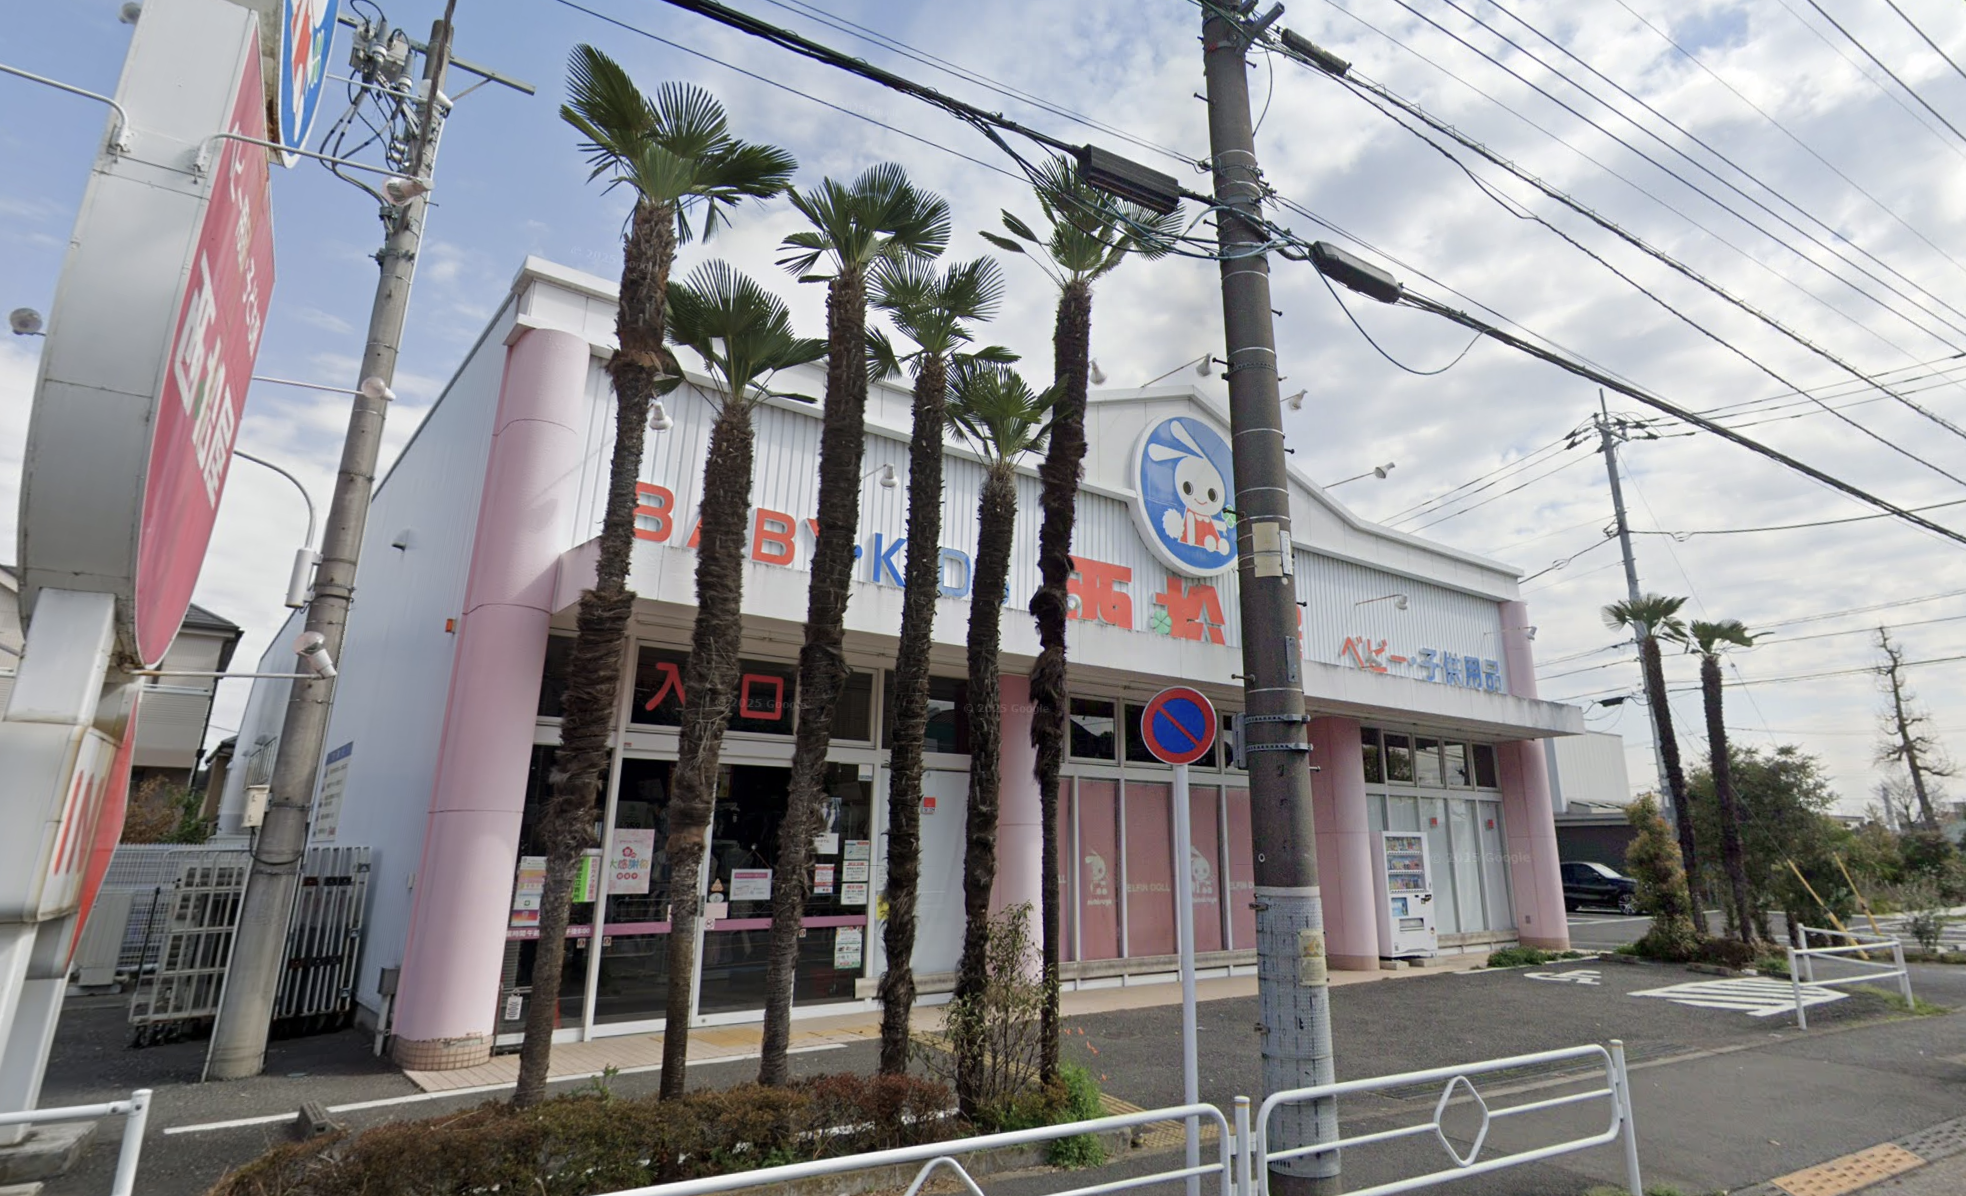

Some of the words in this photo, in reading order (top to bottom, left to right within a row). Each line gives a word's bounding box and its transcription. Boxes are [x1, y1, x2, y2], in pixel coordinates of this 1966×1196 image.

[1067, 555, 1303, 660] 西松
[644, 662, 784, 721] 入口
[1338, 636, 1502, 692] ベビー・子供用品
